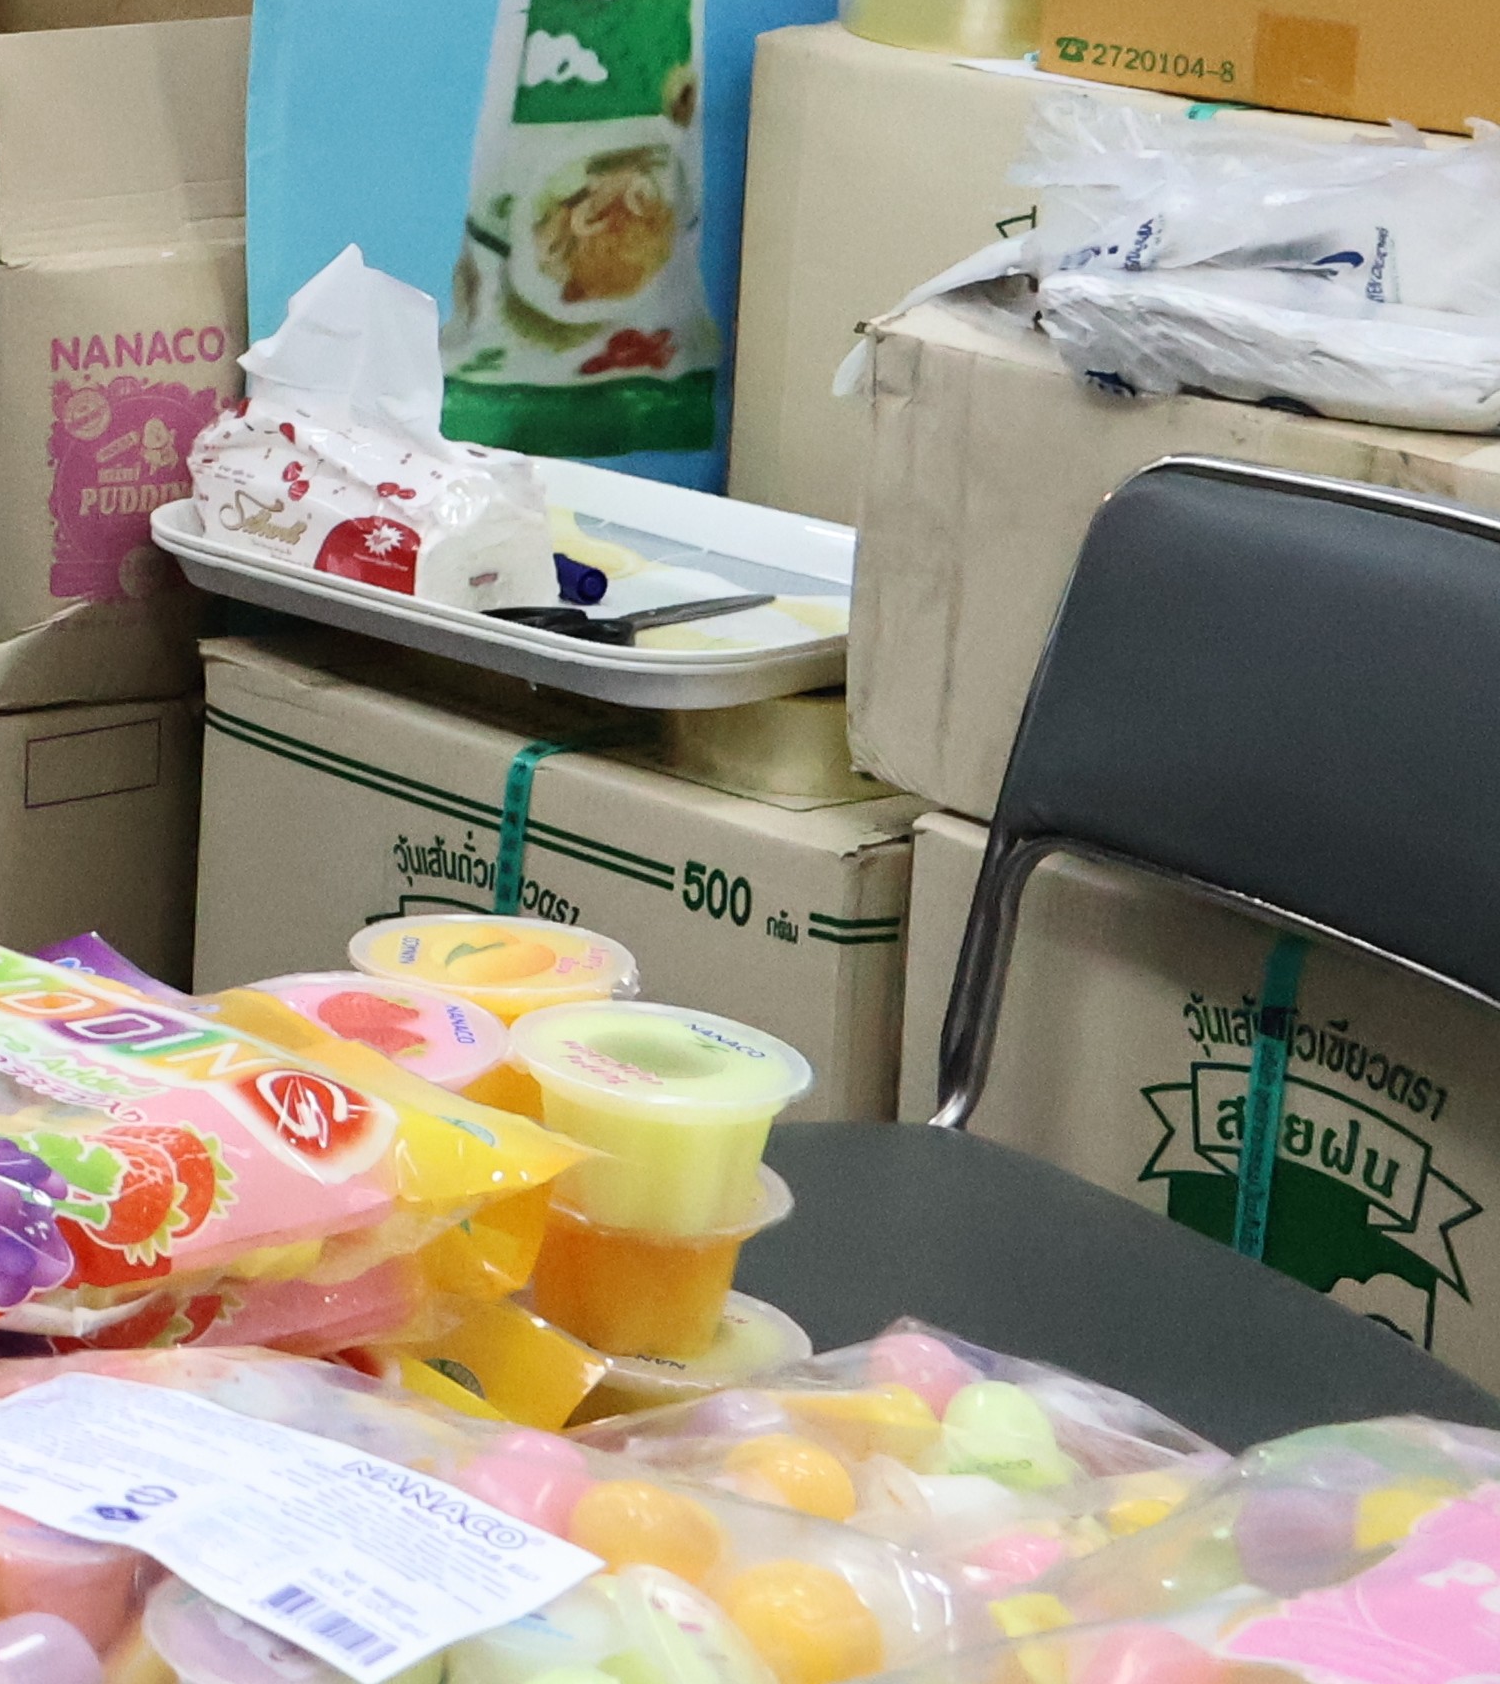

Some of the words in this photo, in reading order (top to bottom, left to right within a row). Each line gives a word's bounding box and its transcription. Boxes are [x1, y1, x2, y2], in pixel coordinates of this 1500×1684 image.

[1091, 42, 1236, 84] 2720104-8
[50, 326, 227, 372] NANACO
[682, 859, 753, 928] 500
[446, 1003, 476, 1046] NANACO
[684, 1022, 767, 1061] NANACO
[1215, 1096, 1400, 1199] สยฝน
[341, 1459, 531, 1552] NANACO
